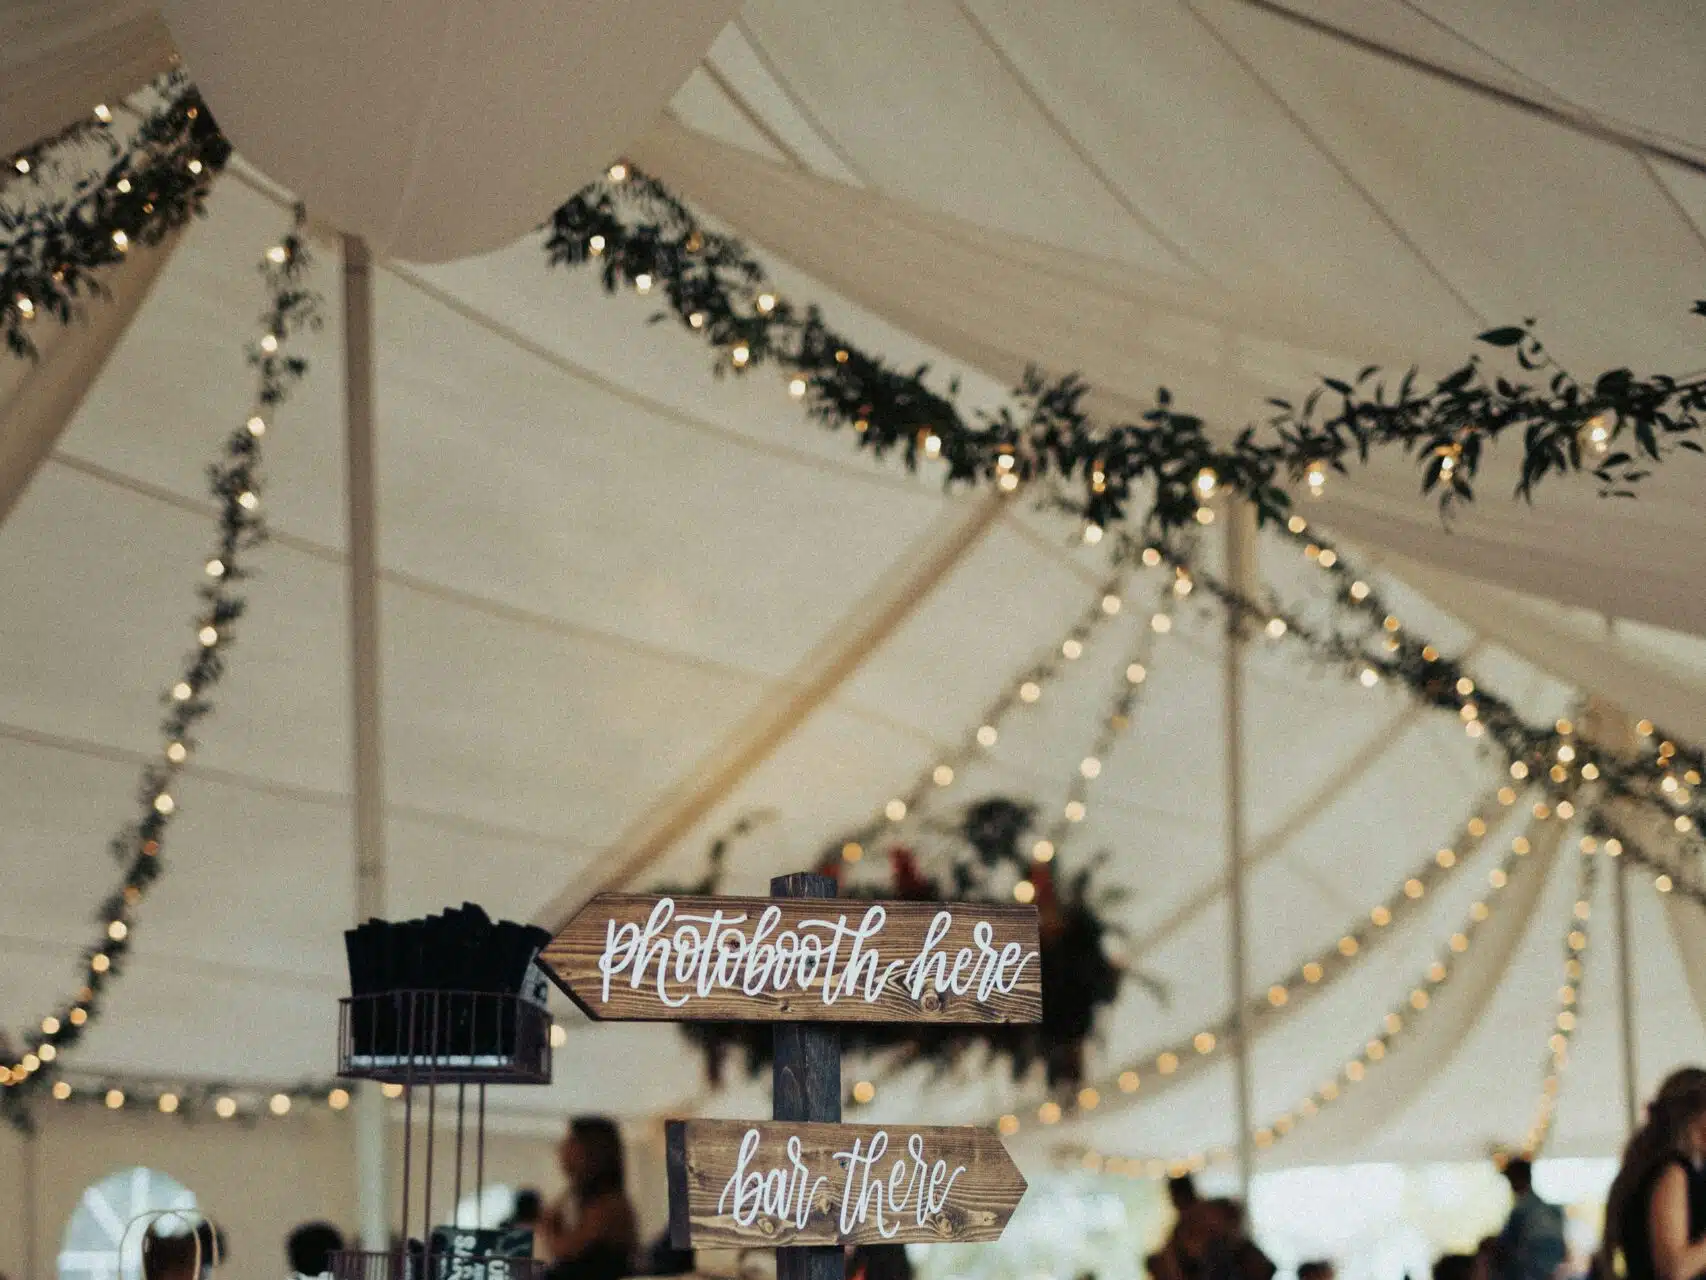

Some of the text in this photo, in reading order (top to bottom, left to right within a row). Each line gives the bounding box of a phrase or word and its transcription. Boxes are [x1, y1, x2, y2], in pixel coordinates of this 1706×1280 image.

[598, 897, 1038, 1007] photobooth here
[718, 1129, 966, 1238] bar there
